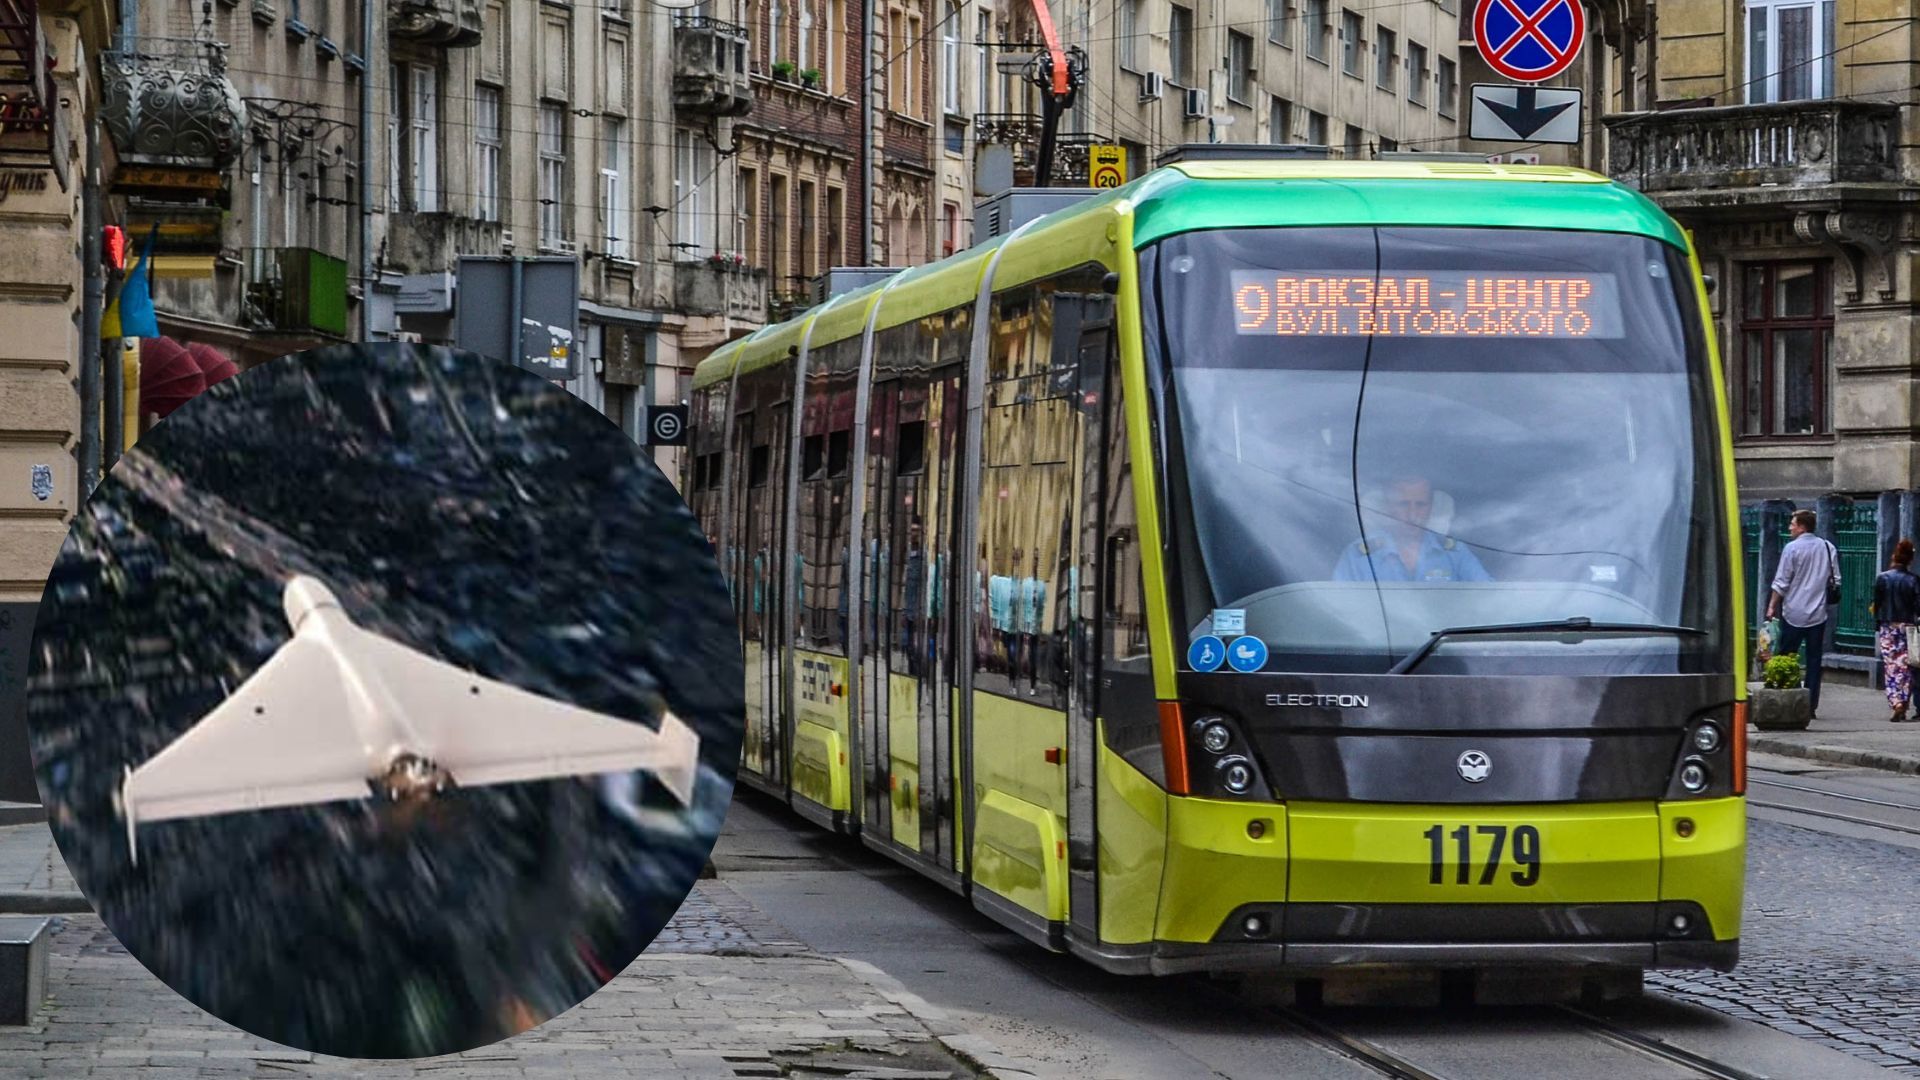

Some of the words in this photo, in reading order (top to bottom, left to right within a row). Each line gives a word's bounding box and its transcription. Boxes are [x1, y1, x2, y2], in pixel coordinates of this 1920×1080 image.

[1100, 175, 1117, 188] 20
[1236, 284, 1270, 328] 9
[1276, 278, 1429, 307] ВОКЗАЛ
[1466, 278, 1592, 311] ЦЕНТР
[1276, 309, 1349, 334] ВУЛ.
[1358, 309, 1592, 335] ВІТОВСЬКОГО
[1265, 694, 1369, 707] ELECTRON
[1424, 824, 1541, 887] 1179
